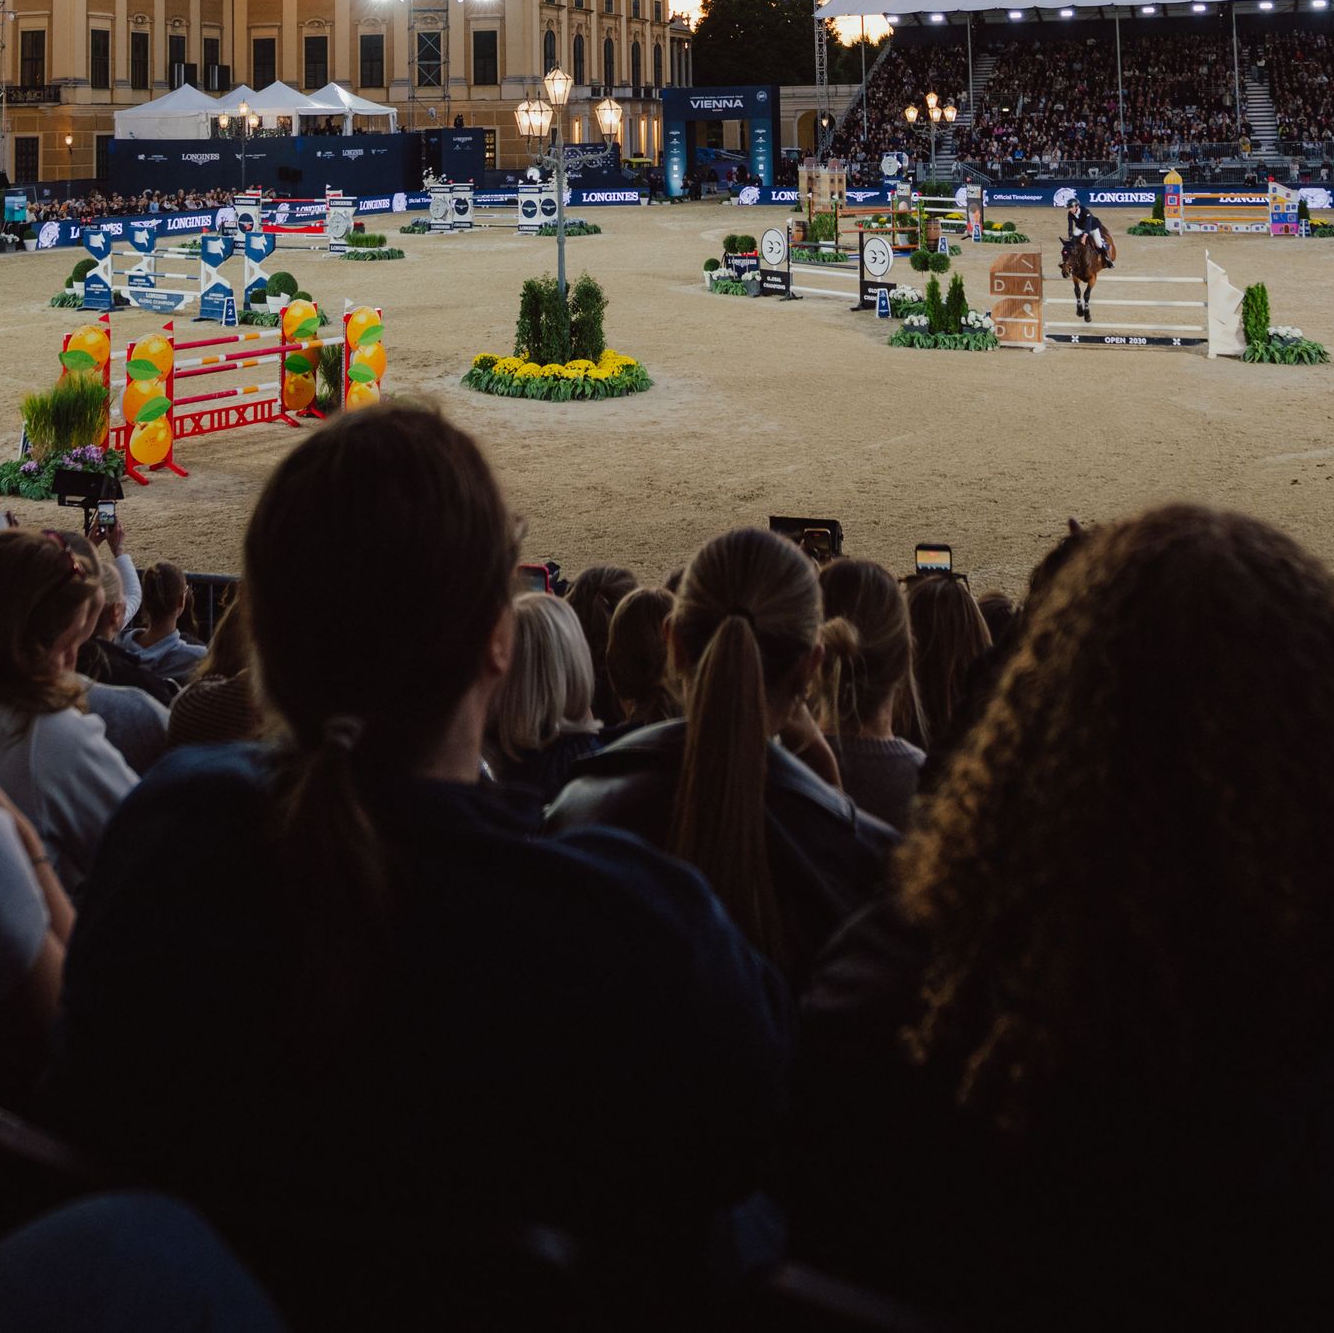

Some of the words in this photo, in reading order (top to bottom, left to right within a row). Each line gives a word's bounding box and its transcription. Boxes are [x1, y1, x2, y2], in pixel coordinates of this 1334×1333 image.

[690, 100, 744, 108] VIENNA
[582, 192, 639, 202] LONGINES
[1089, 192, 1155, 202] LONGINES
[359, 198, 390, 211] LONGINES
[167, 216, 212, 230] LONGINES
[1105, 336, 1125, 344] OPEN
